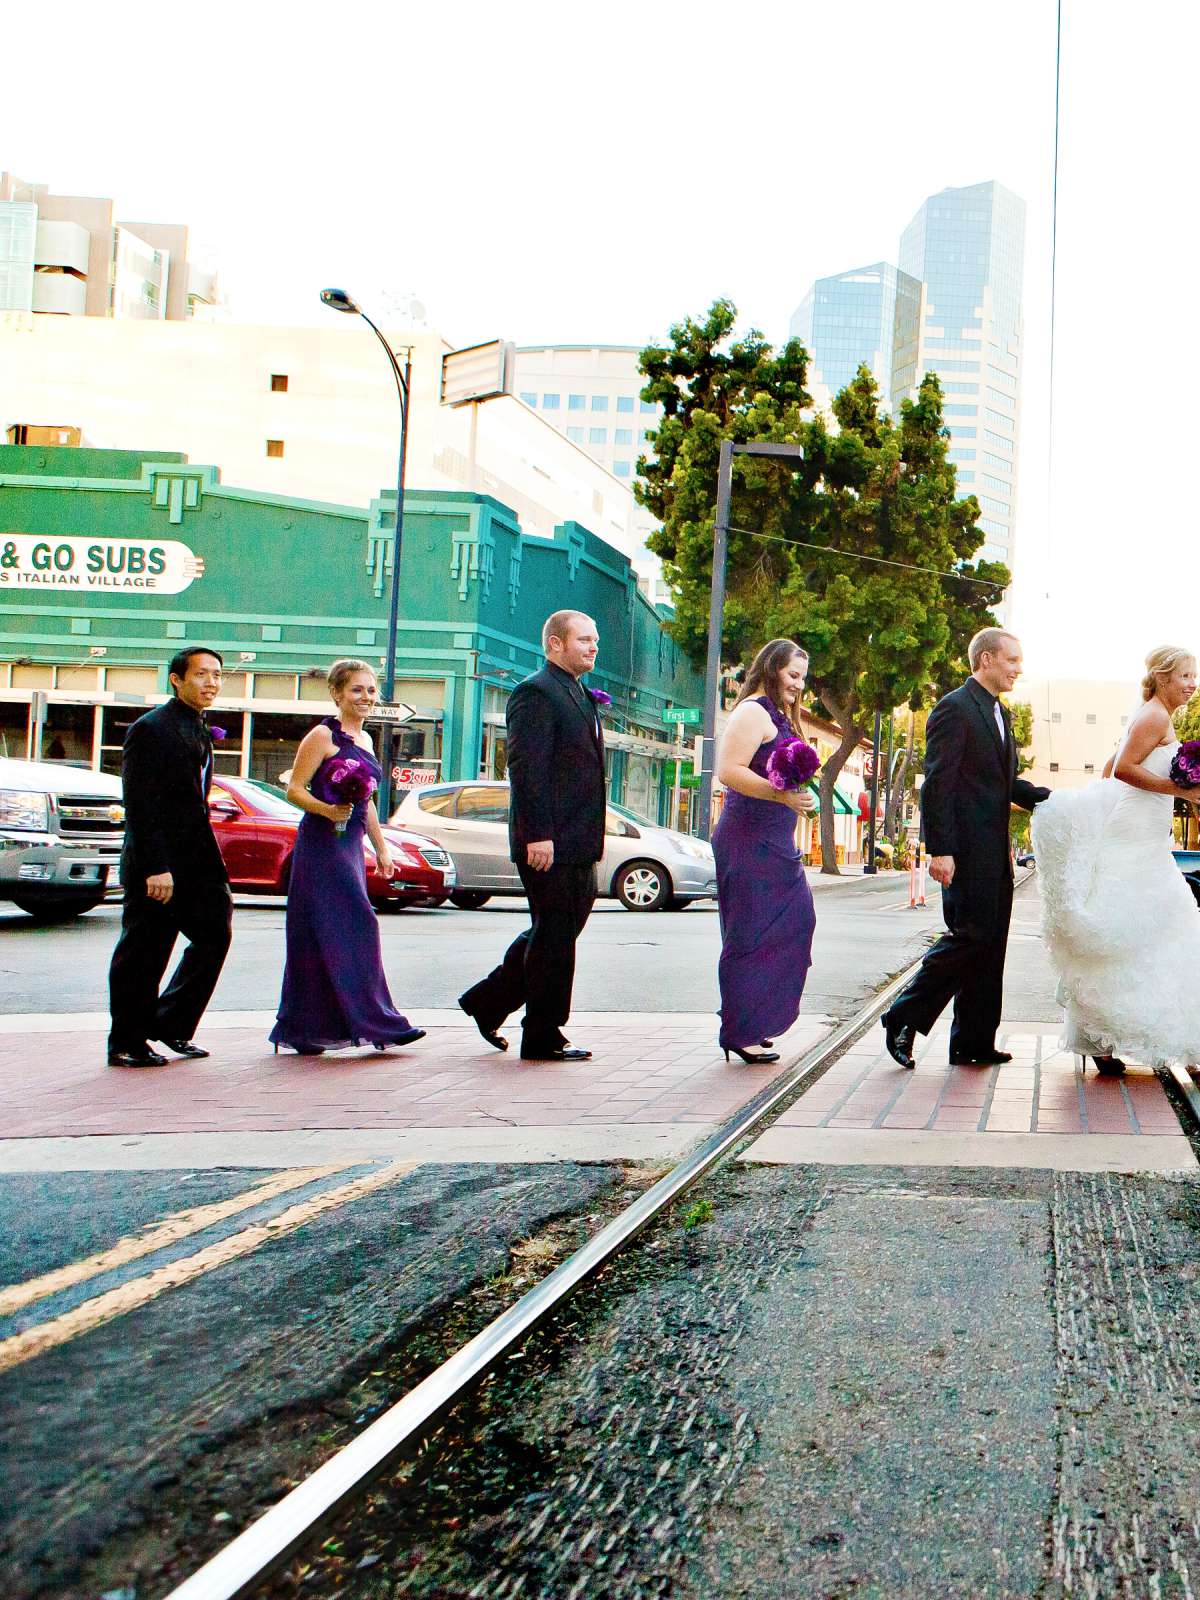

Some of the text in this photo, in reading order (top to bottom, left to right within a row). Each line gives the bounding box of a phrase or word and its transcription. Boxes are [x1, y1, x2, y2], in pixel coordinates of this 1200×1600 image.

[1, 541, 167, 575] & GO SUBS
[17, 572, 80, 585] ITALIAN
[87, 575, 157, 588] VILLAGE
[381, 708, 398, 716] WAY
[667, 711, 685, 720] First
[392, 766, 412, 783] $5
[413, 774, 435, 784] SUB
